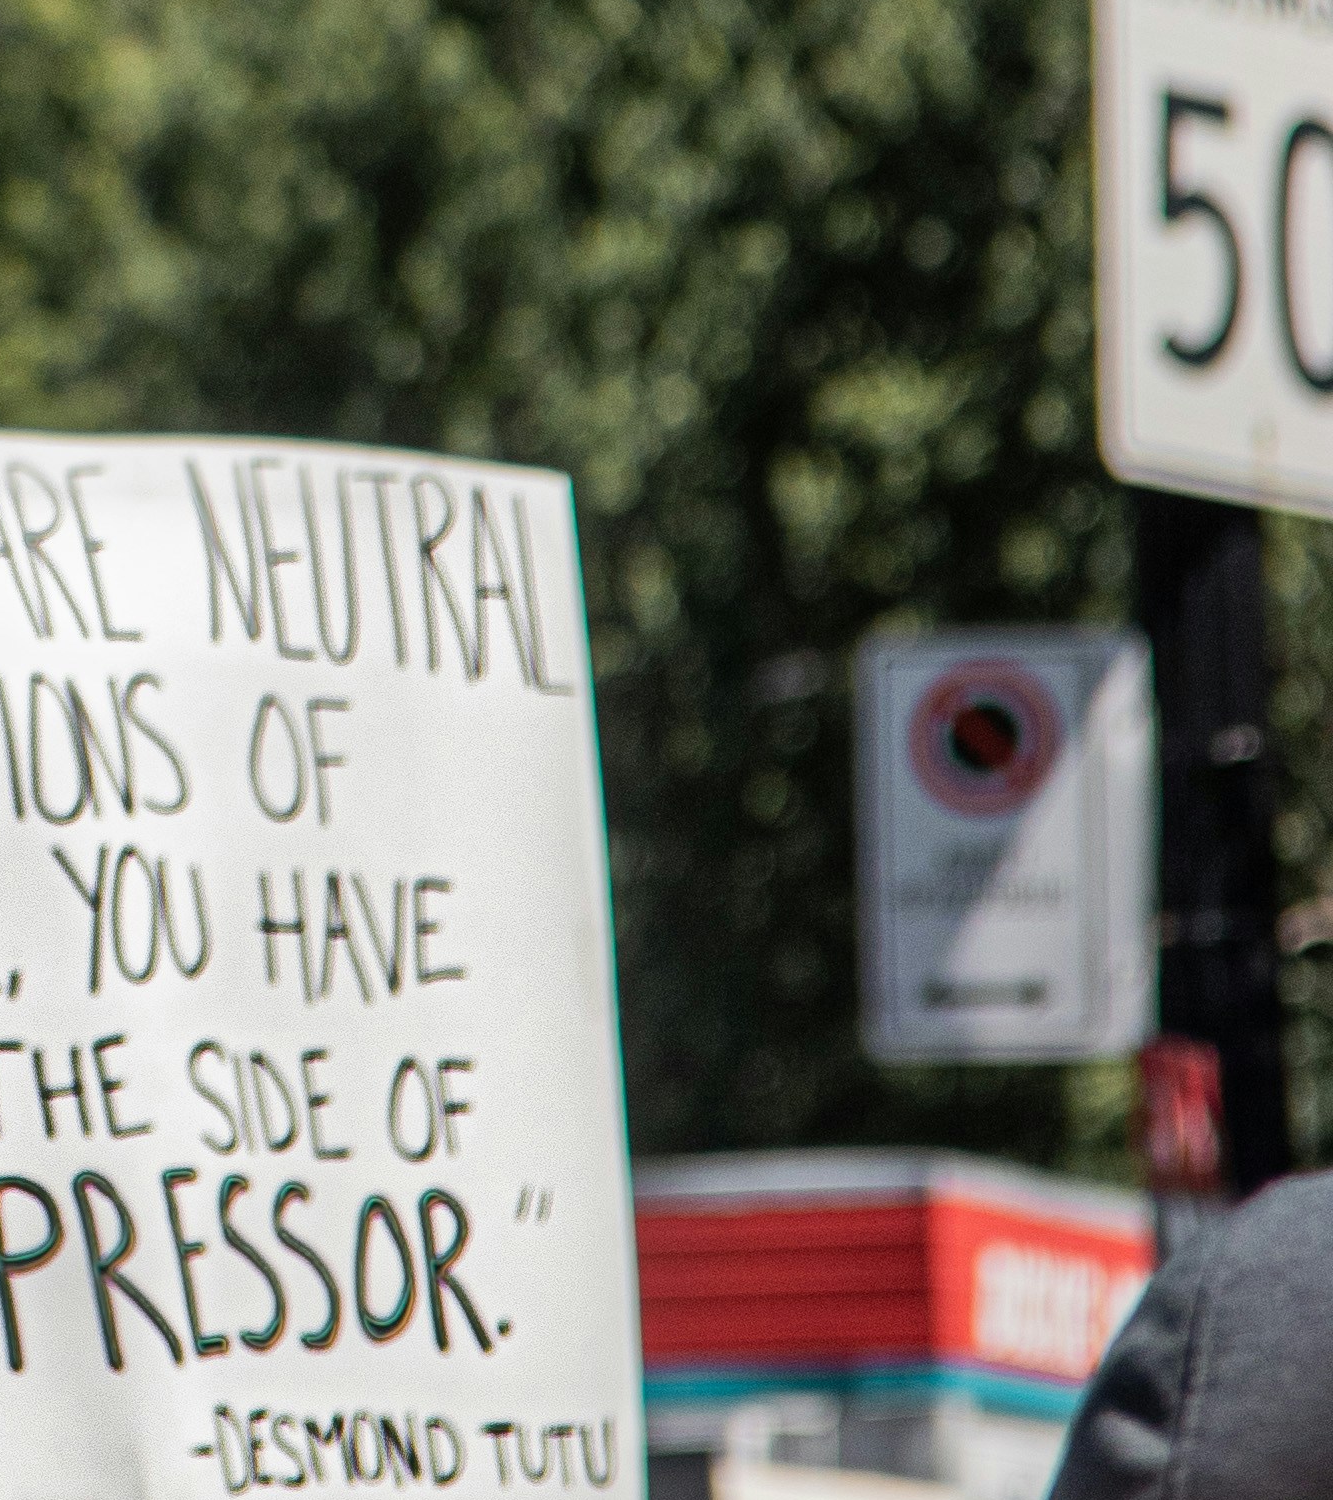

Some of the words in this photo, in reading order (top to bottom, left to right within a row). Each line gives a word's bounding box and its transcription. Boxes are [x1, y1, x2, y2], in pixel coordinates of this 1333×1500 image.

[183, 452, 575, 697] NEUTRAL
[248, 690, 351, 828] OF
[50, 843, 212, 995] YOU
[257, 867, 467, 1004] HAVE
[186, 1037, 353, 1160] SIDE
[386, 1054, 475, 1162] OF
[190, 1402, 468, 1494] -DESMOND
[481, 1420, 617, 1490] TUTU
